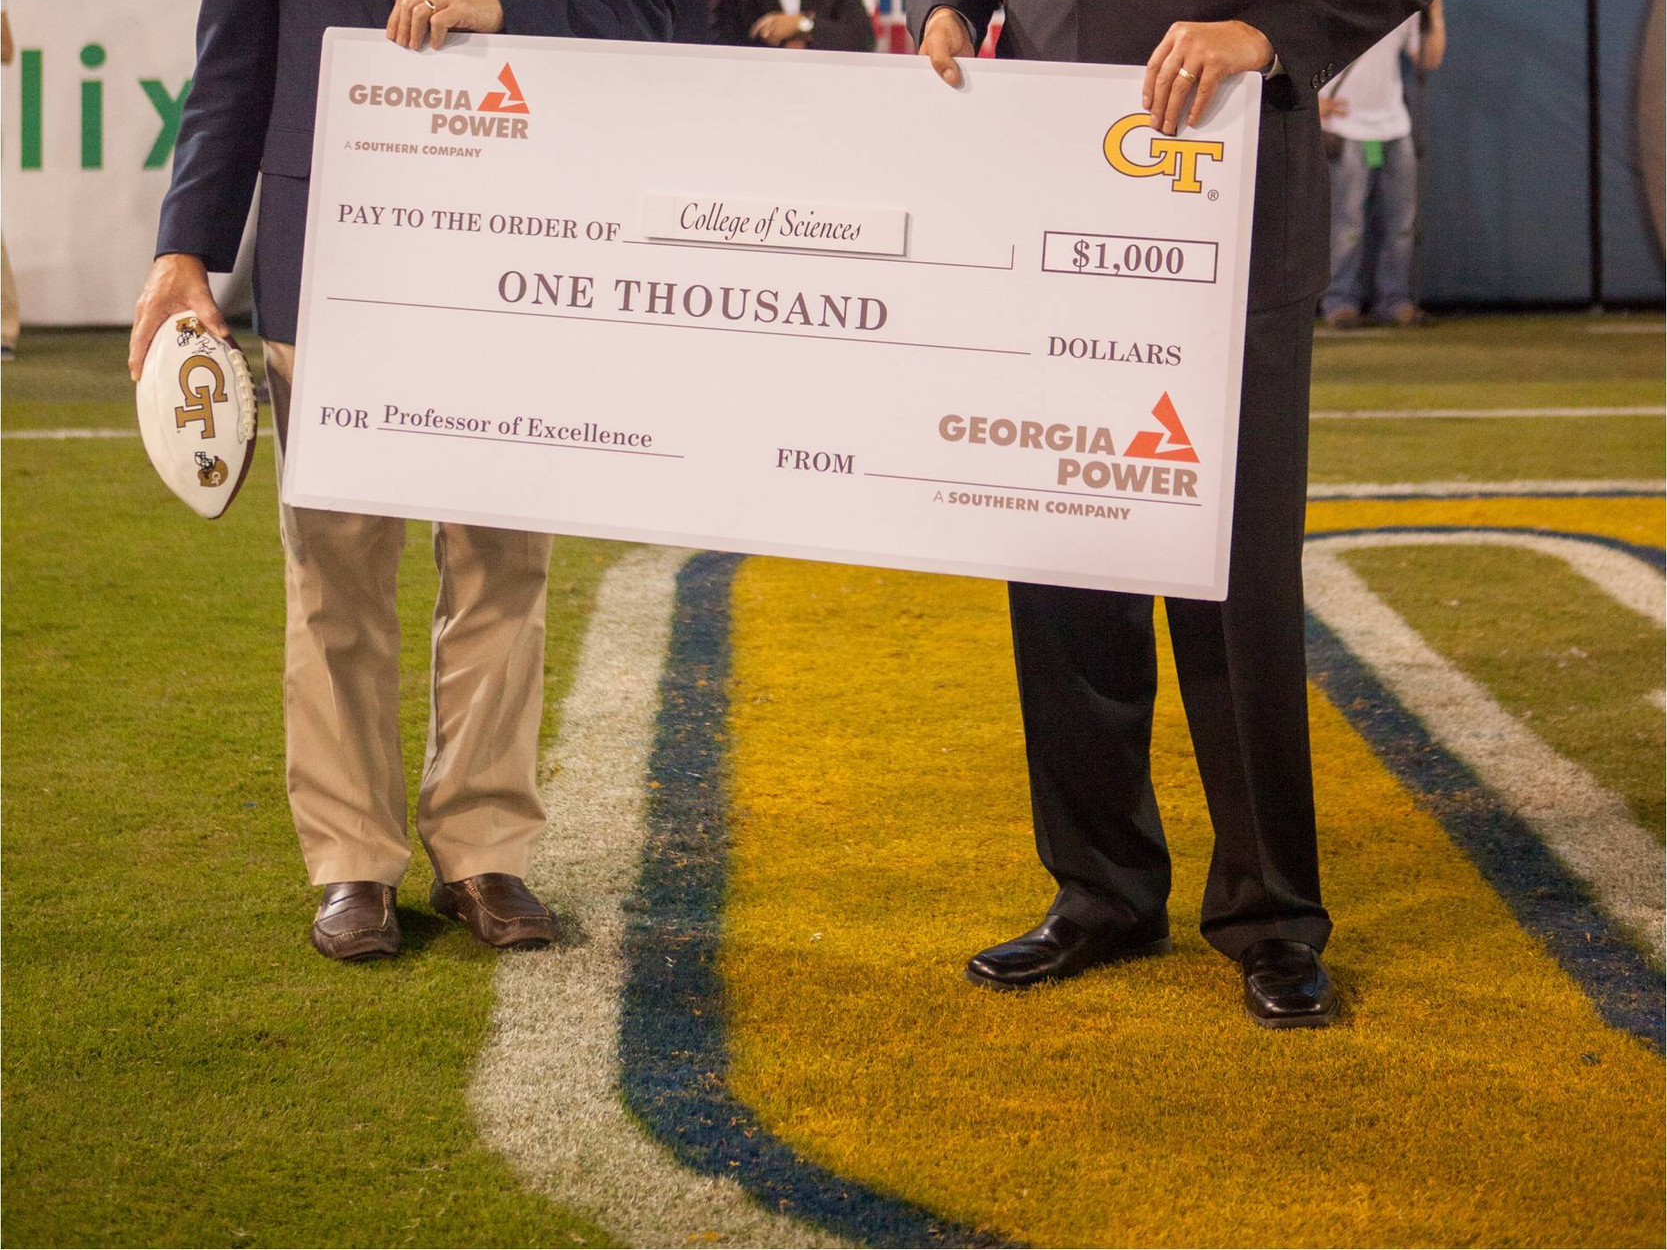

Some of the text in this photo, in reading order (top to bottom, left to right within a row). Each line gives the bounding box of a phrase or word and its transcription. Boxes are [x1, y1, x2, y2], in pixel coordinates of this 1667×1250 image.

[348, 83, 472, 111] GEORGIA
[431, 113, 529, 140] POWER
[344, 140, 482, 158] A SOUTHERN COMPANY
[337, 203, 622, 243] PAY TO THE ORDER OF
[680, 202, 862, 242] College of Sciences
[1072, 240, 1185, 276] $1,000
[497, 270, 888, 331] ONE THOUSAND
[1046, 336, 1182, 367] DOLLARS
[319, 404, 653, 449] FOR Professor of Excellence
[938, 414, 1116, 456] GEORGIA
[774, 448, 856, 475] FROM
[1057, 458, 1198, 498] POWER
[933, 490, 1131, 521] A SOUTHERN COMPANY
